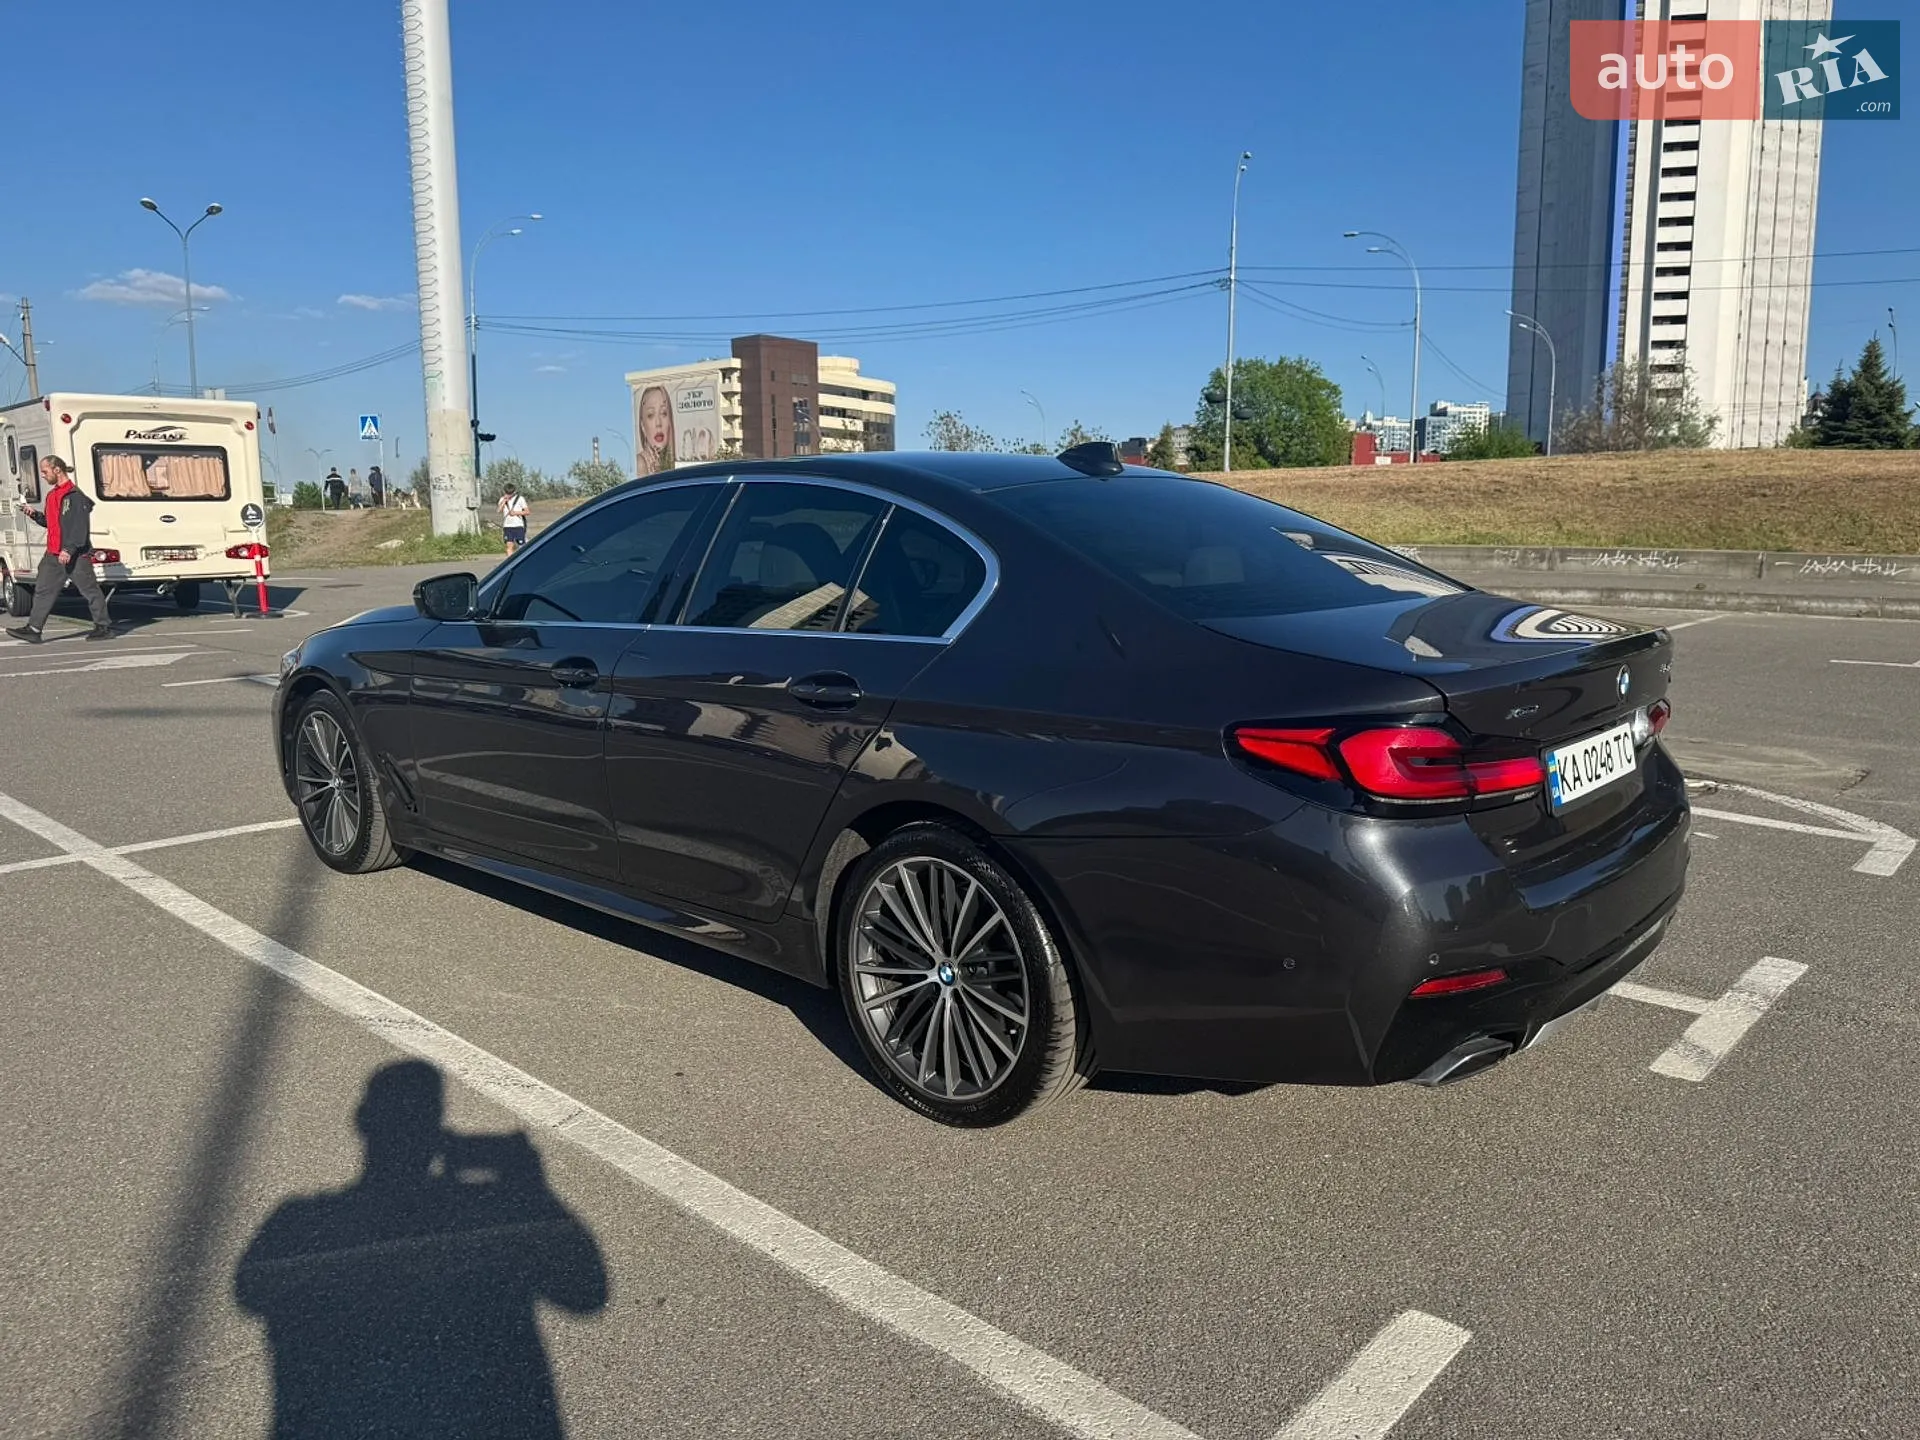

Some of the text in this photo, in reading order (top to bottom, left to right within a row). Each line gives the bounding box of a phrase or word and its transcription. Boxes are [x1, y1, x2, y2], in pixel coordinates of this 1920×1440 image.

[1557, 731, 1633, 796] KA 0248 TC
